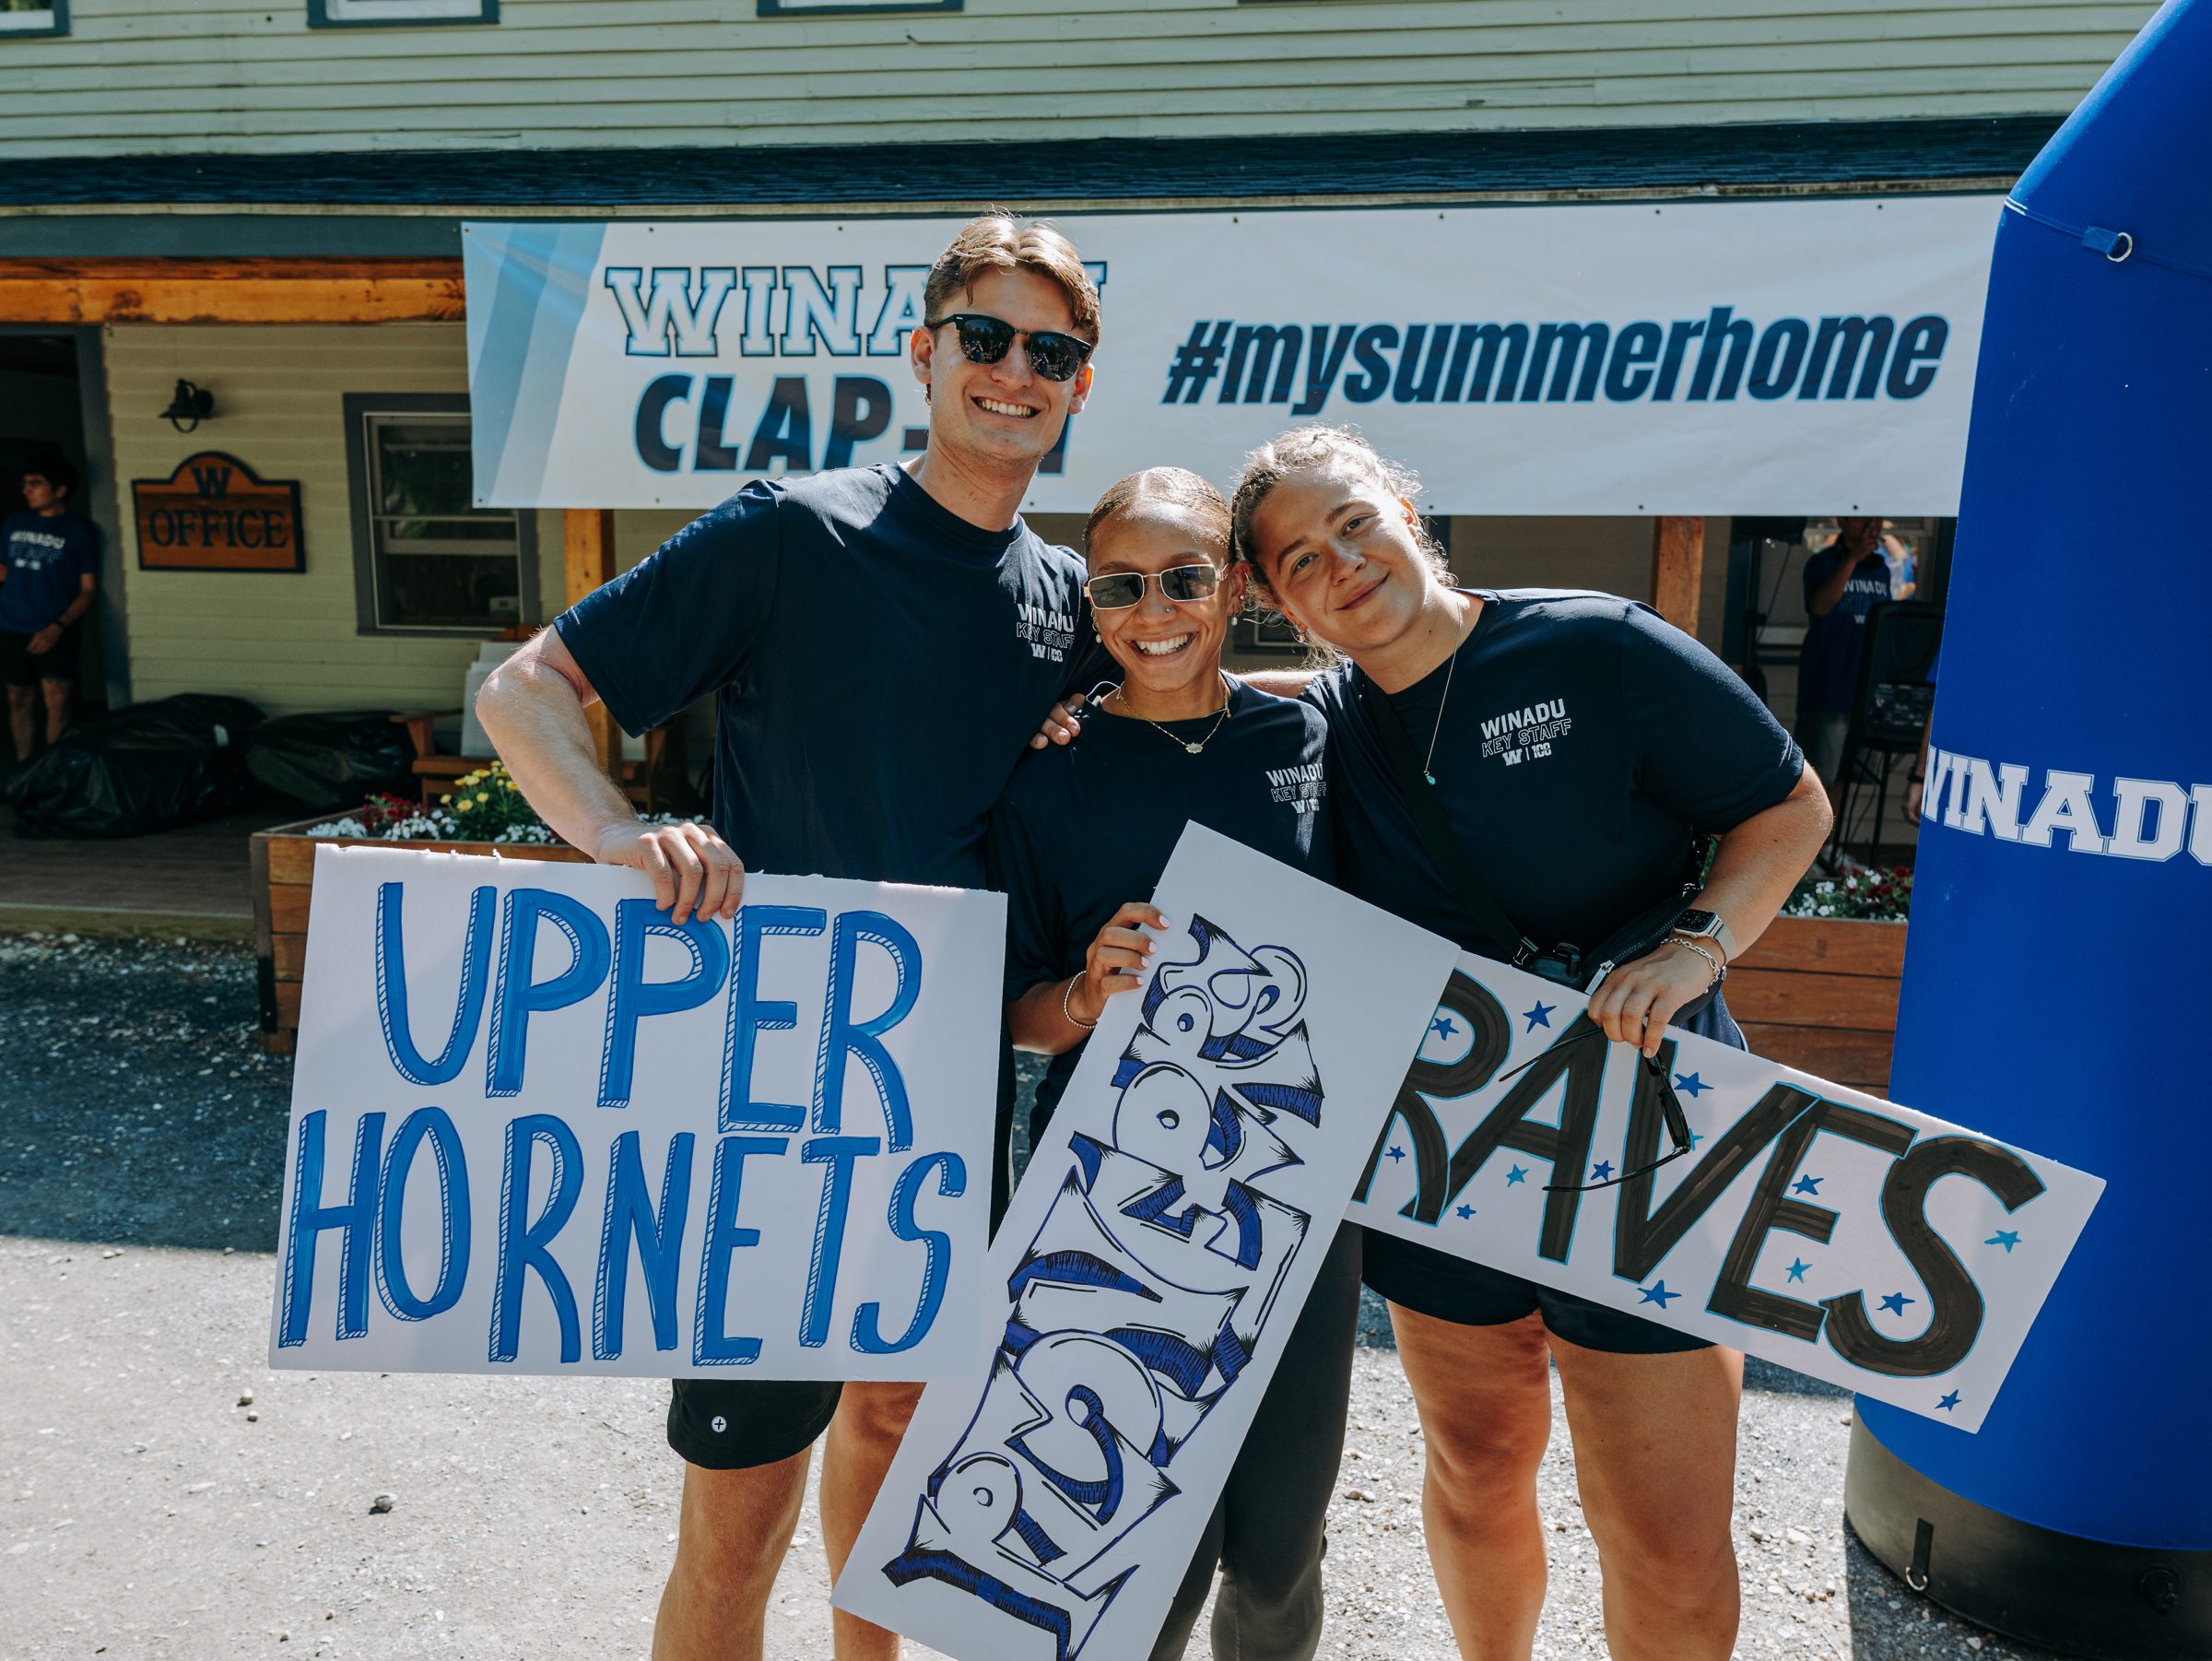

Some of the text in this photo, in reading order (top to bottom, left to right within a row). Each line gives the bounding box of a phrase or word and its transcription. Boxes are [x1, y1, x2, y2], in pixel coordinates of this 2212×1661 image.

[604, 261, 1108, 358] WINA
[1160, 304, 1952, 417] #mysummerhome
[192, 467, 232, 499] W
[149, 509, 288, 548] OFFICE
[1017, 604, 1075, 633] WINADU
[1016, 622, 1076, 650] KEY STAFF
[1030, 643, 1046, 659] W
[1480, 698, 1566, 740] WINADU
[1481, 718, 1572, 758] KEY STAFF
[1502, 748, 1523, 766] W
[1265, 762, 1324, 787] WINADU
[1271, 782, 1327, 803] KEY STAFF
[1290, 799, 1306, 814] W
[376, 881, 922, 1152] UPPER
[278, 1106, 968, 1367] HORNETS
